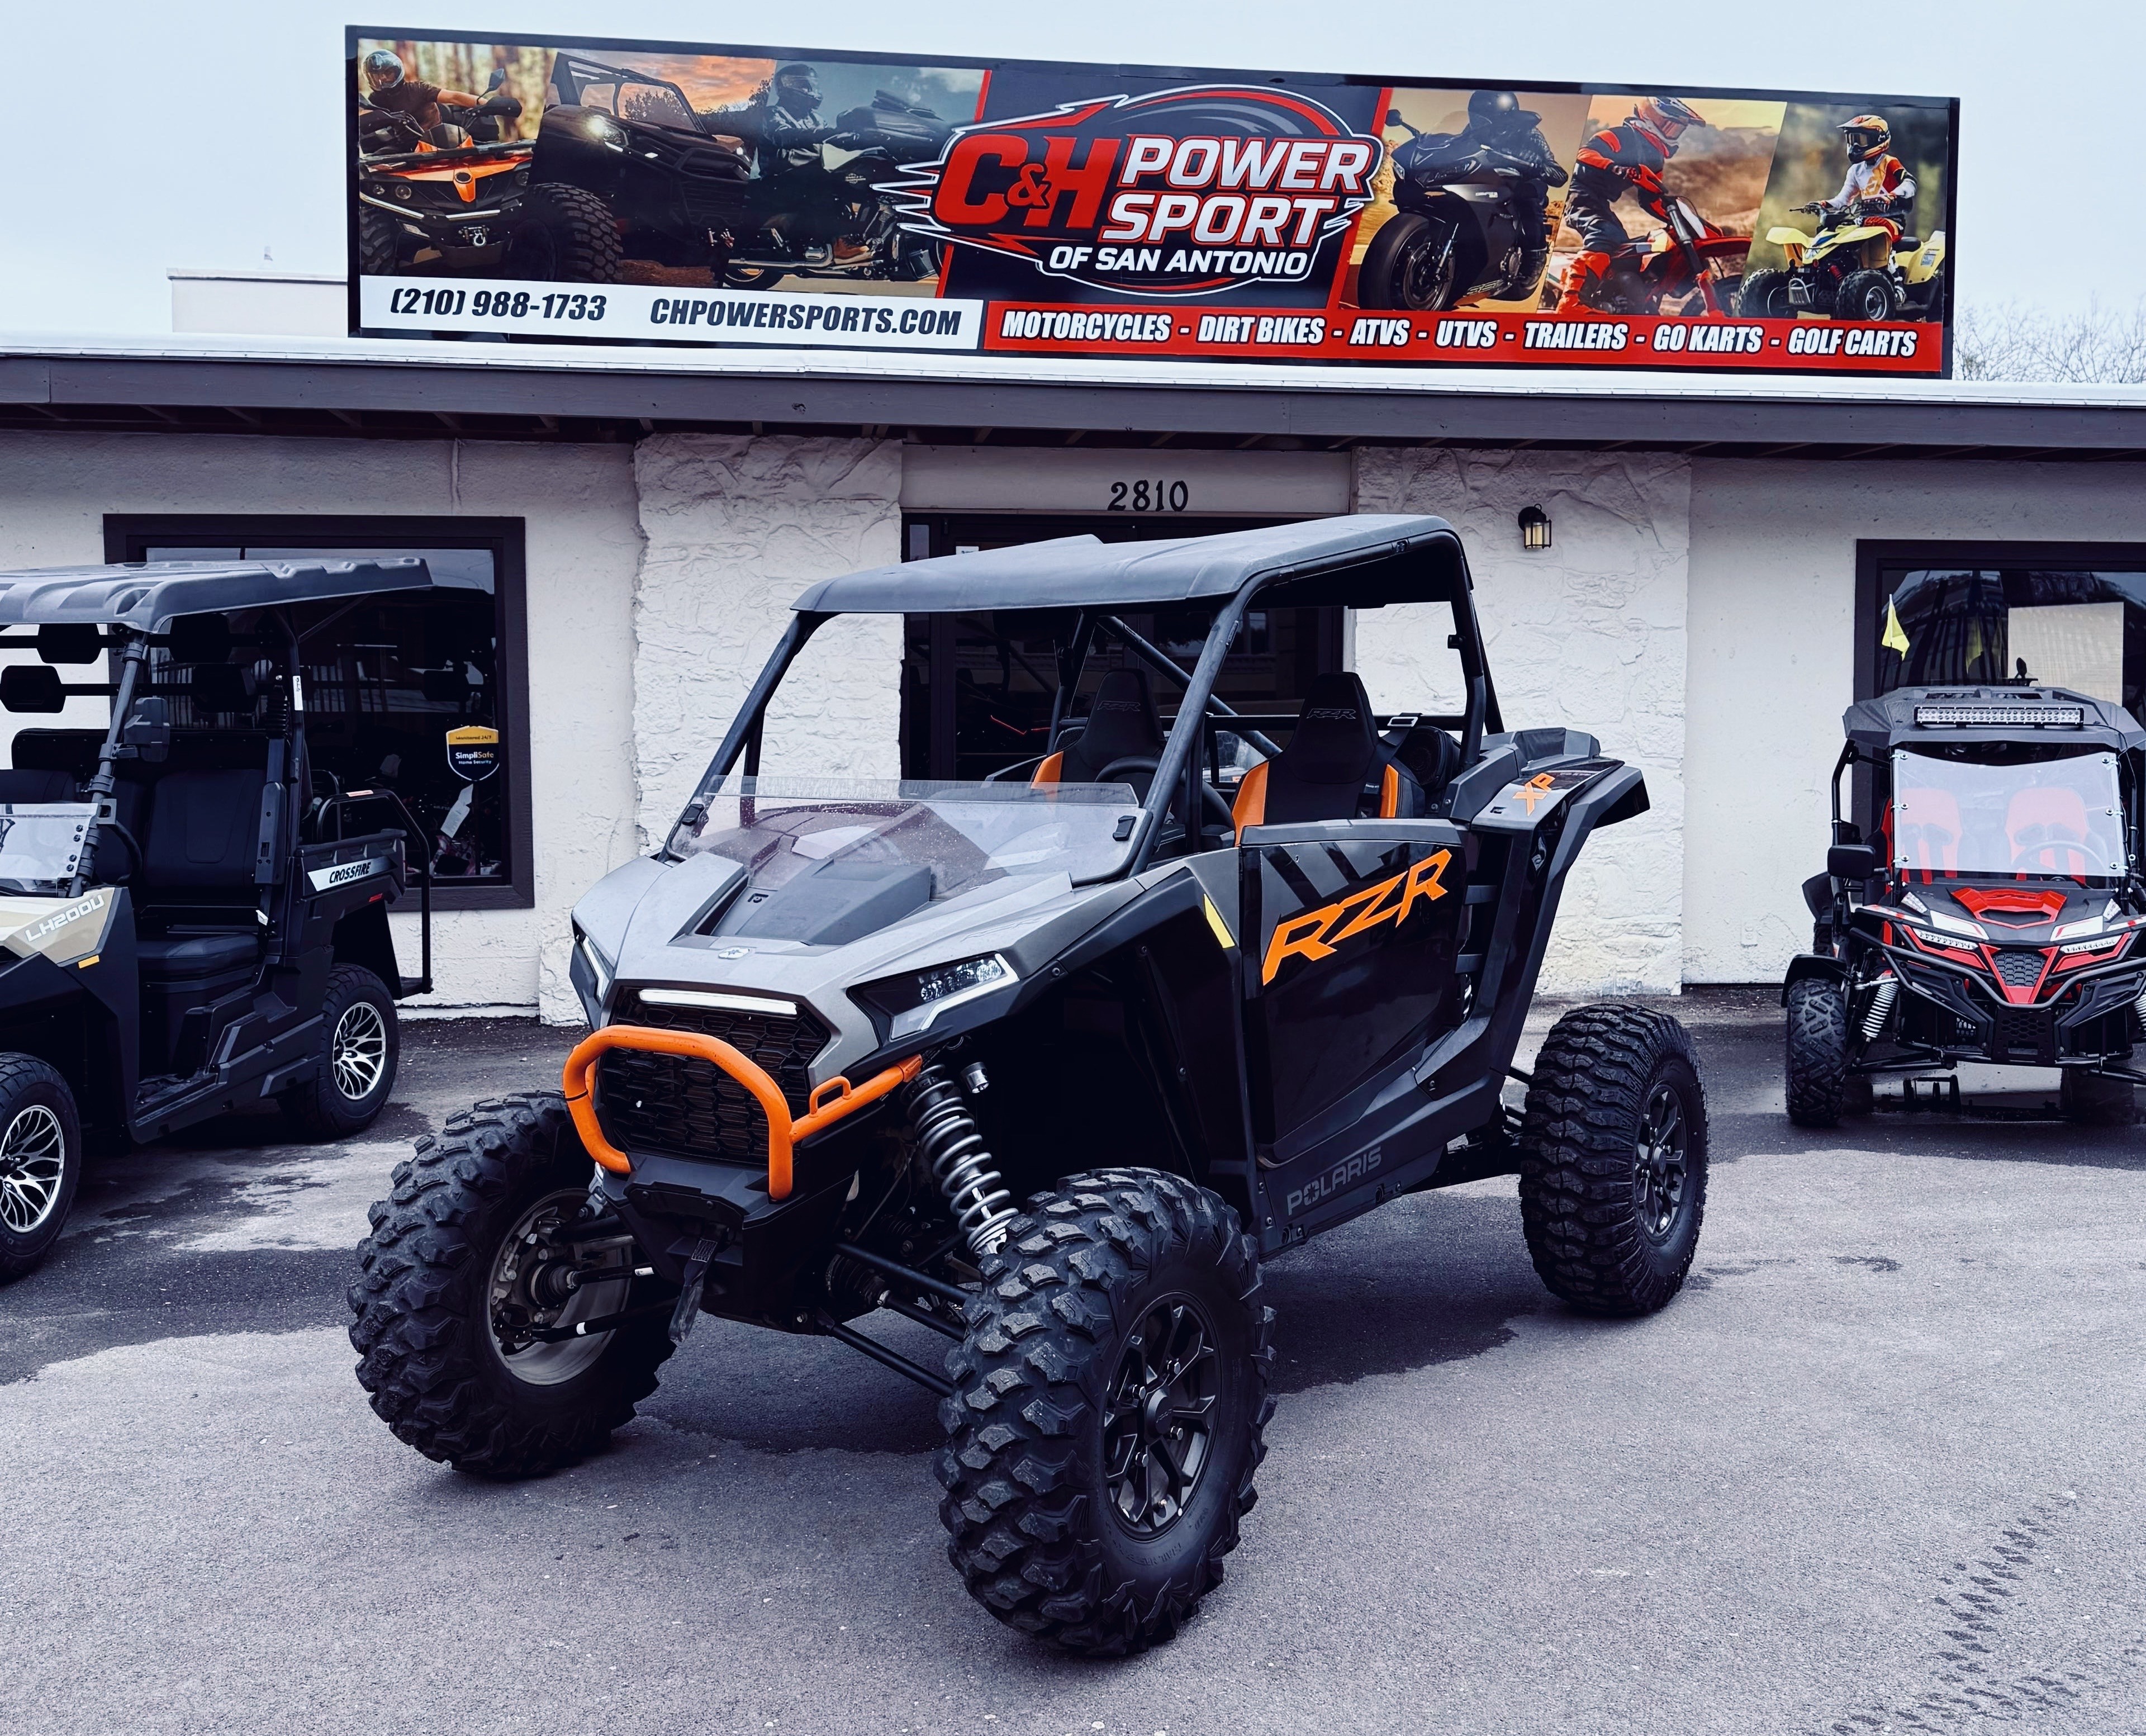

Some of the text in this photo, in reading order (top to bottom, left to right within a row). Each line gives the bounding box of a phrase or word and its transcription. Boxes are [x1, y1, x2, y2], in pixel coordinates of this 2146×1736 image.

[935, 135, 1121, 228] C&H
[1120, 137, 1371, 190] POWER
[1102, 194, 1336, 244] SPORT
[1049, 246, 1308, 274] OF SAN ANTONIO
[390, 288, 607, 321] (210) 988-1733
[650, 298, 962, 335] CHPOWERSPORTS.COM
[1001, 311, 1171, 341] MOTORCYCLES
[1198, 316, 1255, 342] DIRT
[1256, 317, 1325, 344] BIKES
[1350, 319, 1410, 345] ATVS
[1436, 320, 1497, 347] UTVS
[1525, 322, 1628, 349] TRAILERS
[1654, 325, 1687, 351] GO
[1688, 326, 1763, 353] KARTS
[1788, 328, 1844, 354] GOLF
[1845, 329, 1917, 357] CARTS
[1107, 479, 1189, 512] 2810
[1306, 708, 1356, 719] RZR
[455, 751, 494, 760] SimpliSafe
[1512, 772, 1556, 817] XP
[329, 862, 371, 884] CROSSFIRE
[1262, 848, 1452, 986] RZR
[1287, 1146, 1381, 1216] POLARIS
